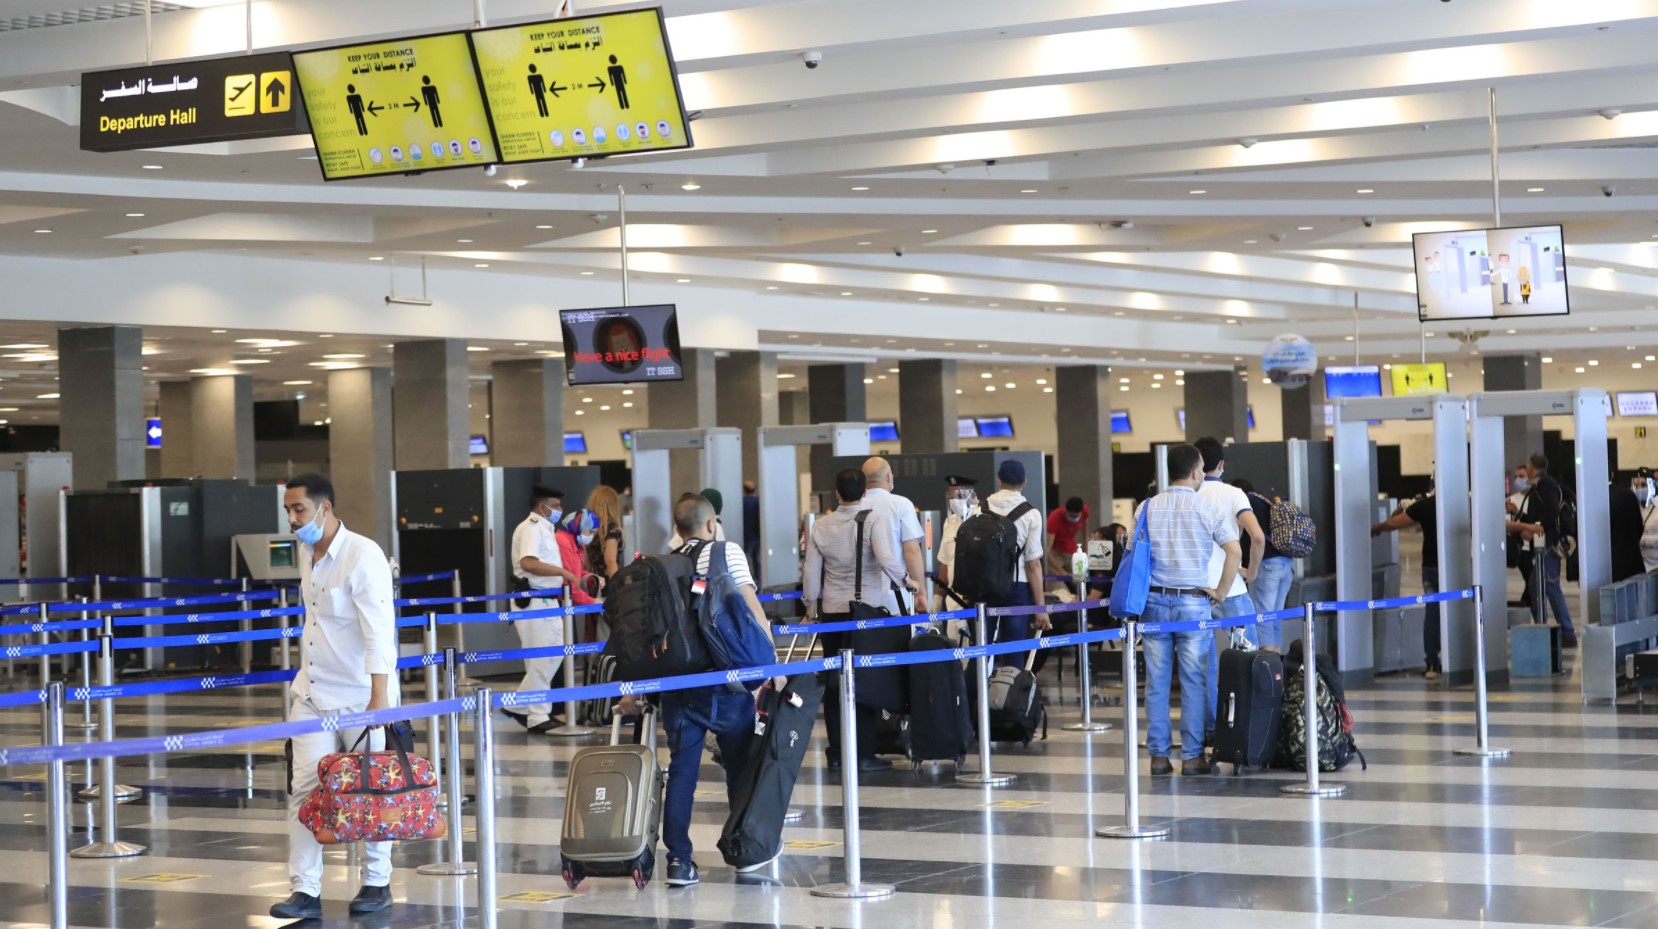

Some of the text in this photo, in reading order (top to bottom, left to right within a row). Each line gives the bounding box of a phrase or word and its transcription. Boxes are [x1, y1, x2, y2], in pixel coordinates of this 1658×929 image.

[530, 26, 600, 41] KEEP YOUR DISTANCE
[347, 48, 414, 63] KEEP YOUR DISTANCE
[484, 68, 505, 78] your
[99, 74, 199, 102] صالة السفر
[488, 80, 517, 92] safety
[306, 88, 326, 99] your
[309, 100, 336, 112] safety
[388, 102, 394, 110] 2
[492, 97, 517, 106] is our
[99, 107, 197, 134] Departure Hall
[313, 116, 337, 125] is our
[496, 111, 536, 122] concern
[318, 129, 356, 140] concern
[574, 347, 671, 363] Have a nice flight
[646, 366, 675, 376] IT SSH
